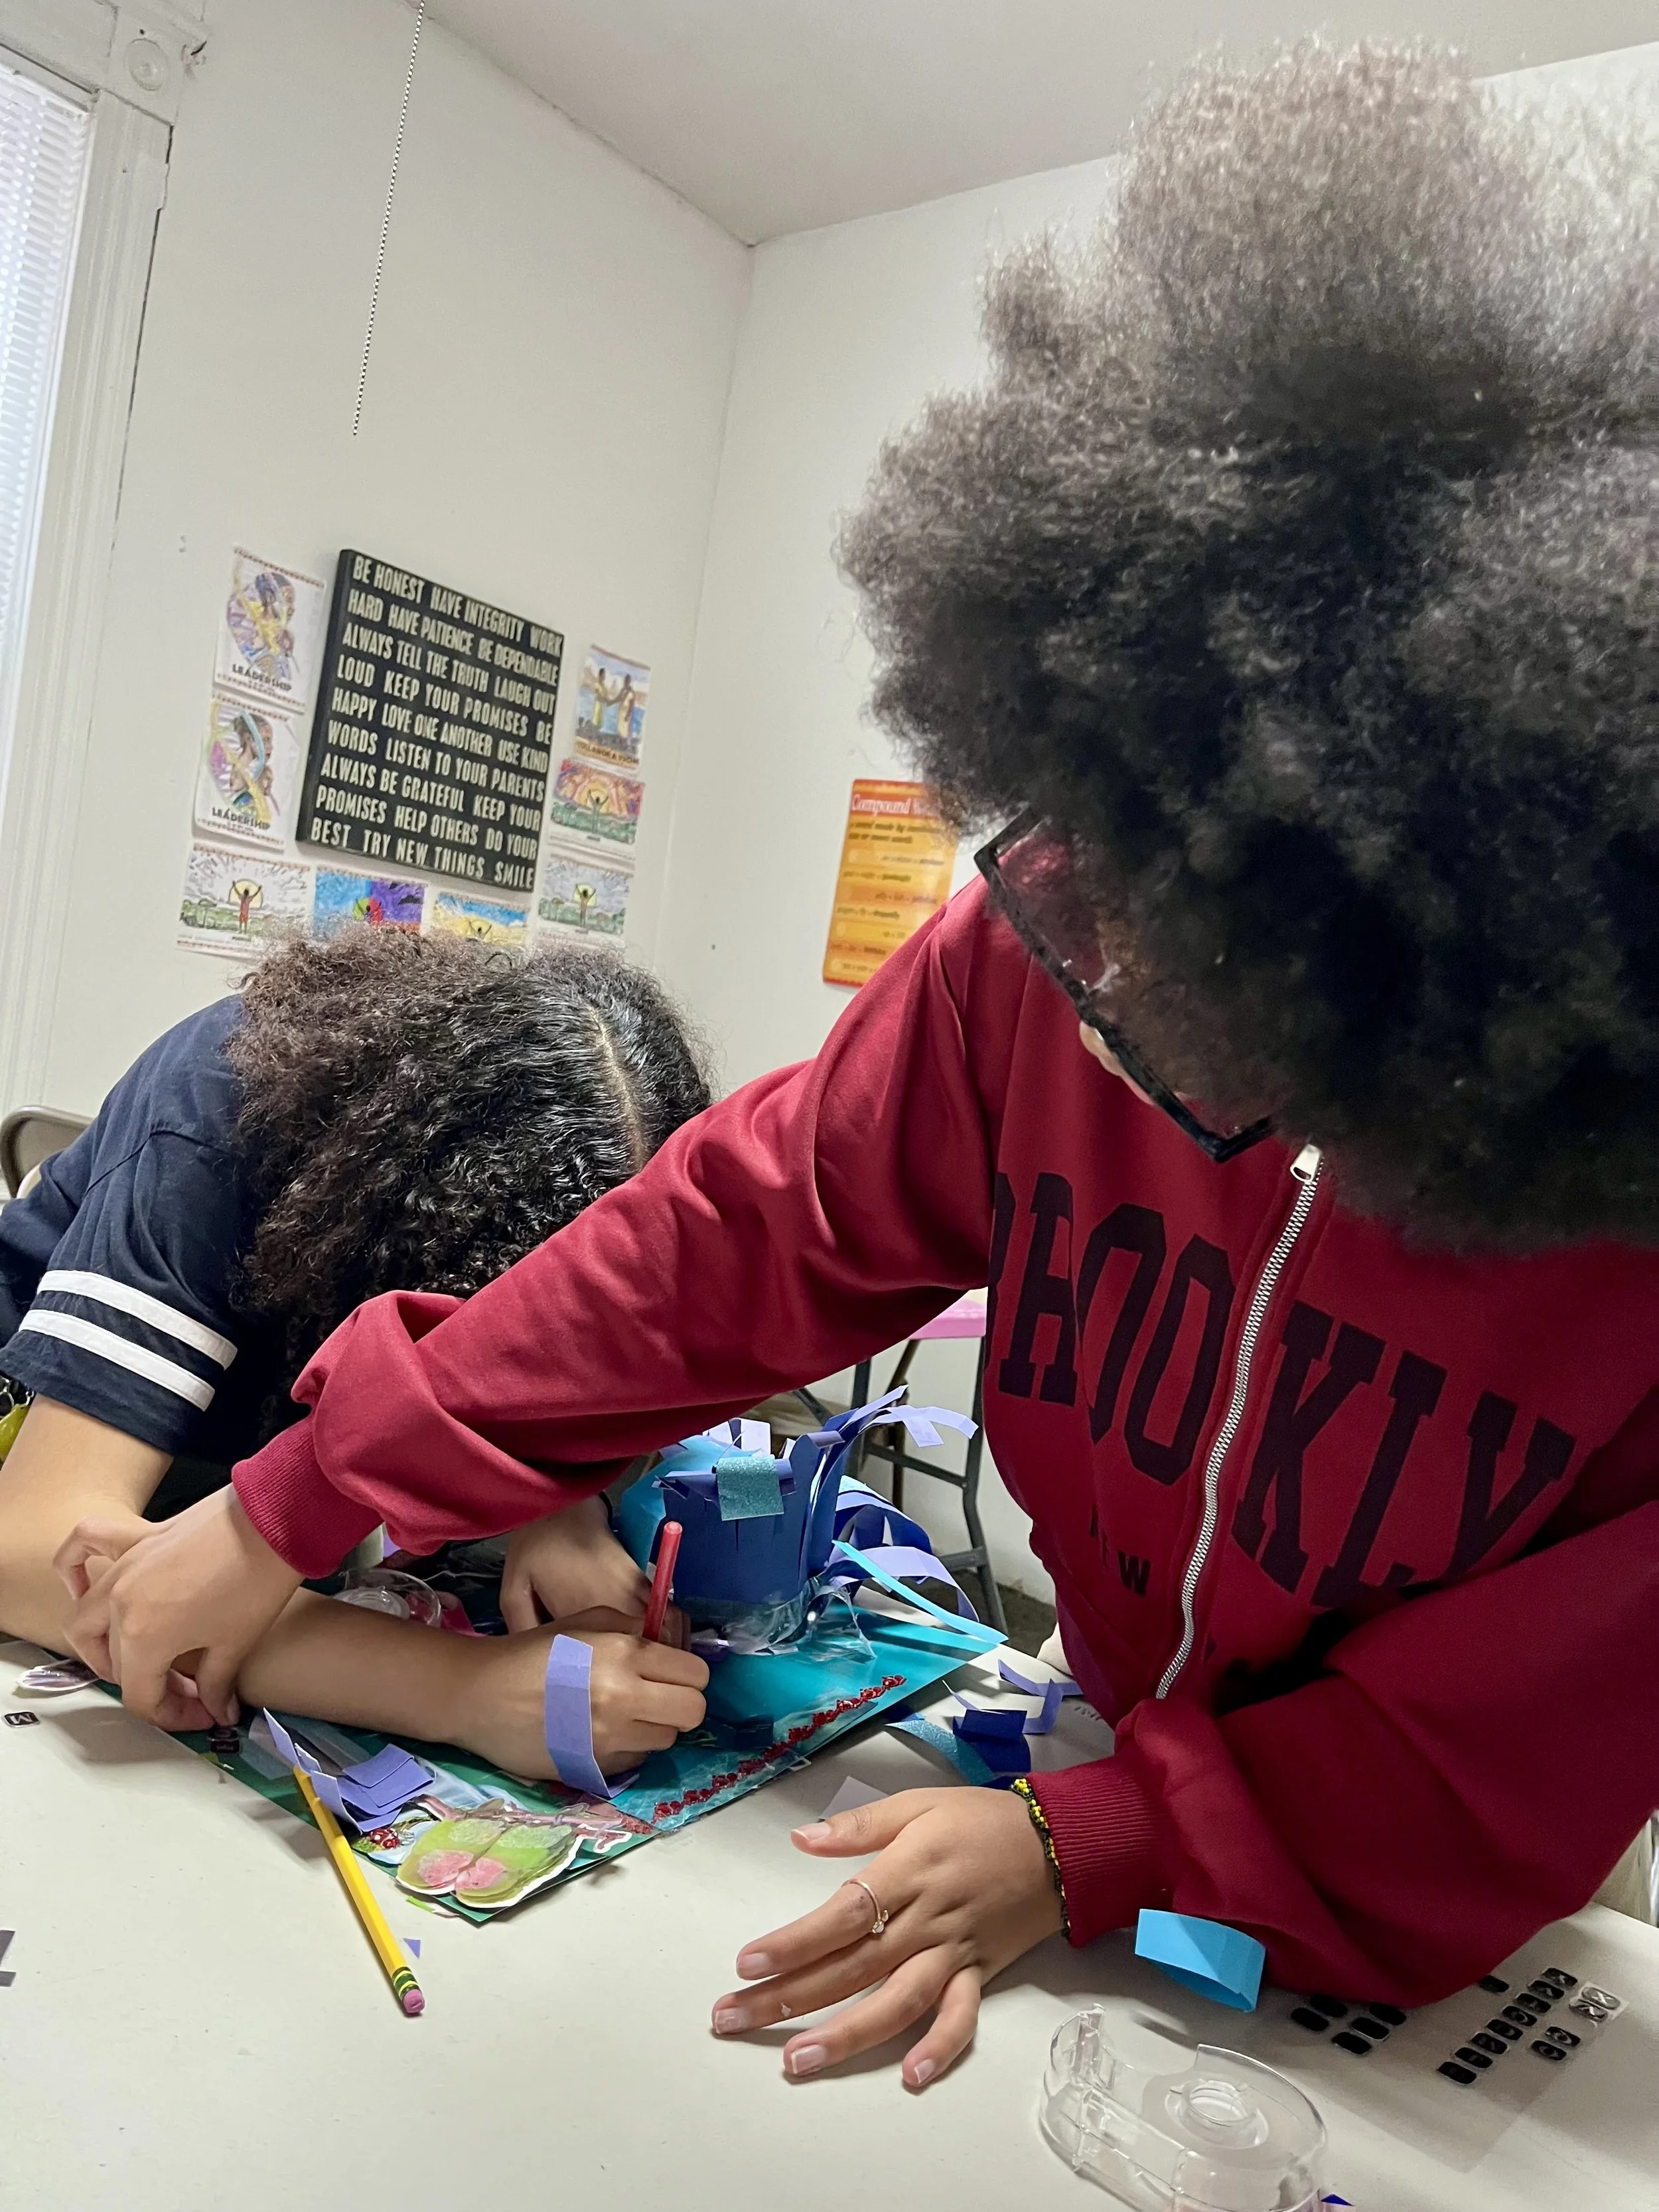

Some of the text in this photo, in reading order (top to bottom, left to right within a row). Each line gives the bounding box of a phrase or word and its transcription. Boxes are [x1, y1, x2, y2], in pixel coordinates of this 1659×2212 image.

[348, 589, 557, 686] HARD HAVE PATIENCE BE DEPENDABLE
[353, 556, 372, 583] BE
[374, 565, 424, 603] HONEST
[430, 587, 463, 619] HAVE
[465, 601, 524, 641] INTEGRITY
[337, 654, 552, 745] LOUD KEEP YOUR PROMISES BE
[342, 623, 555, 715] ALWAYS TELL THE TRUTH LAUGH OUT
[328, 720, 545, 804] WORDS LISTEN TO YOUR PARENTS
[332, 687, 548, 774] HAPPY LOVE ONE ANOTHER USE KIND
[316, 785, 538, 863] PROMISES HELP OTHERS DO YOUR
[321, 753, 541, 834] ALWAYS BE GRATEFUL KEEP YOUR
[311, 817, 534, 889] BEST TRY NEW THINGS SMILE
